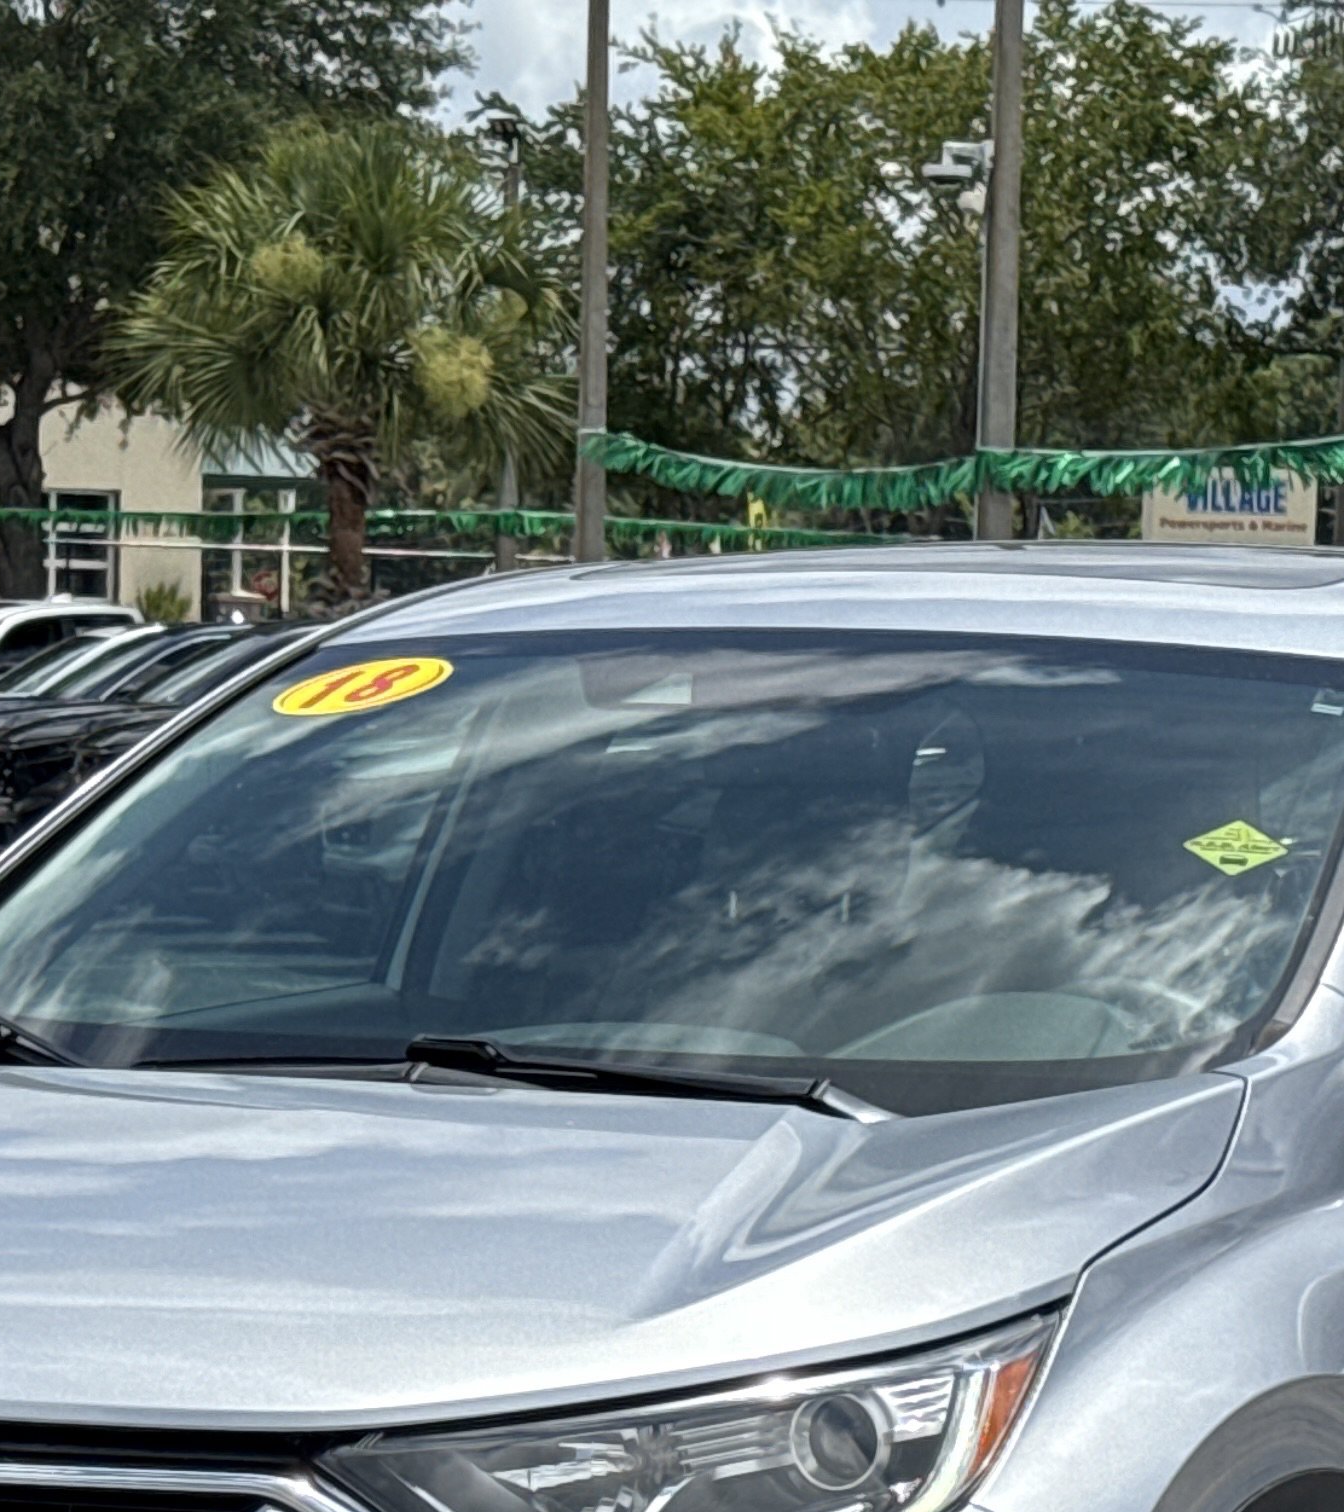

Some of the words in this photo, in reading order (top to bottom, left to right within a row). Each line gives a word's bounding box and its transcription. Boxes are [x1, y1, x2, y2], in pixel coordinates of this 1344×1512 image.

[1187, 479, 1288, 513] VILLAGE
[1159, 516, 1245, 532] Powersports
[1261, 519, 1308, 533] Marine
[299, 664, 420, 709] 18
